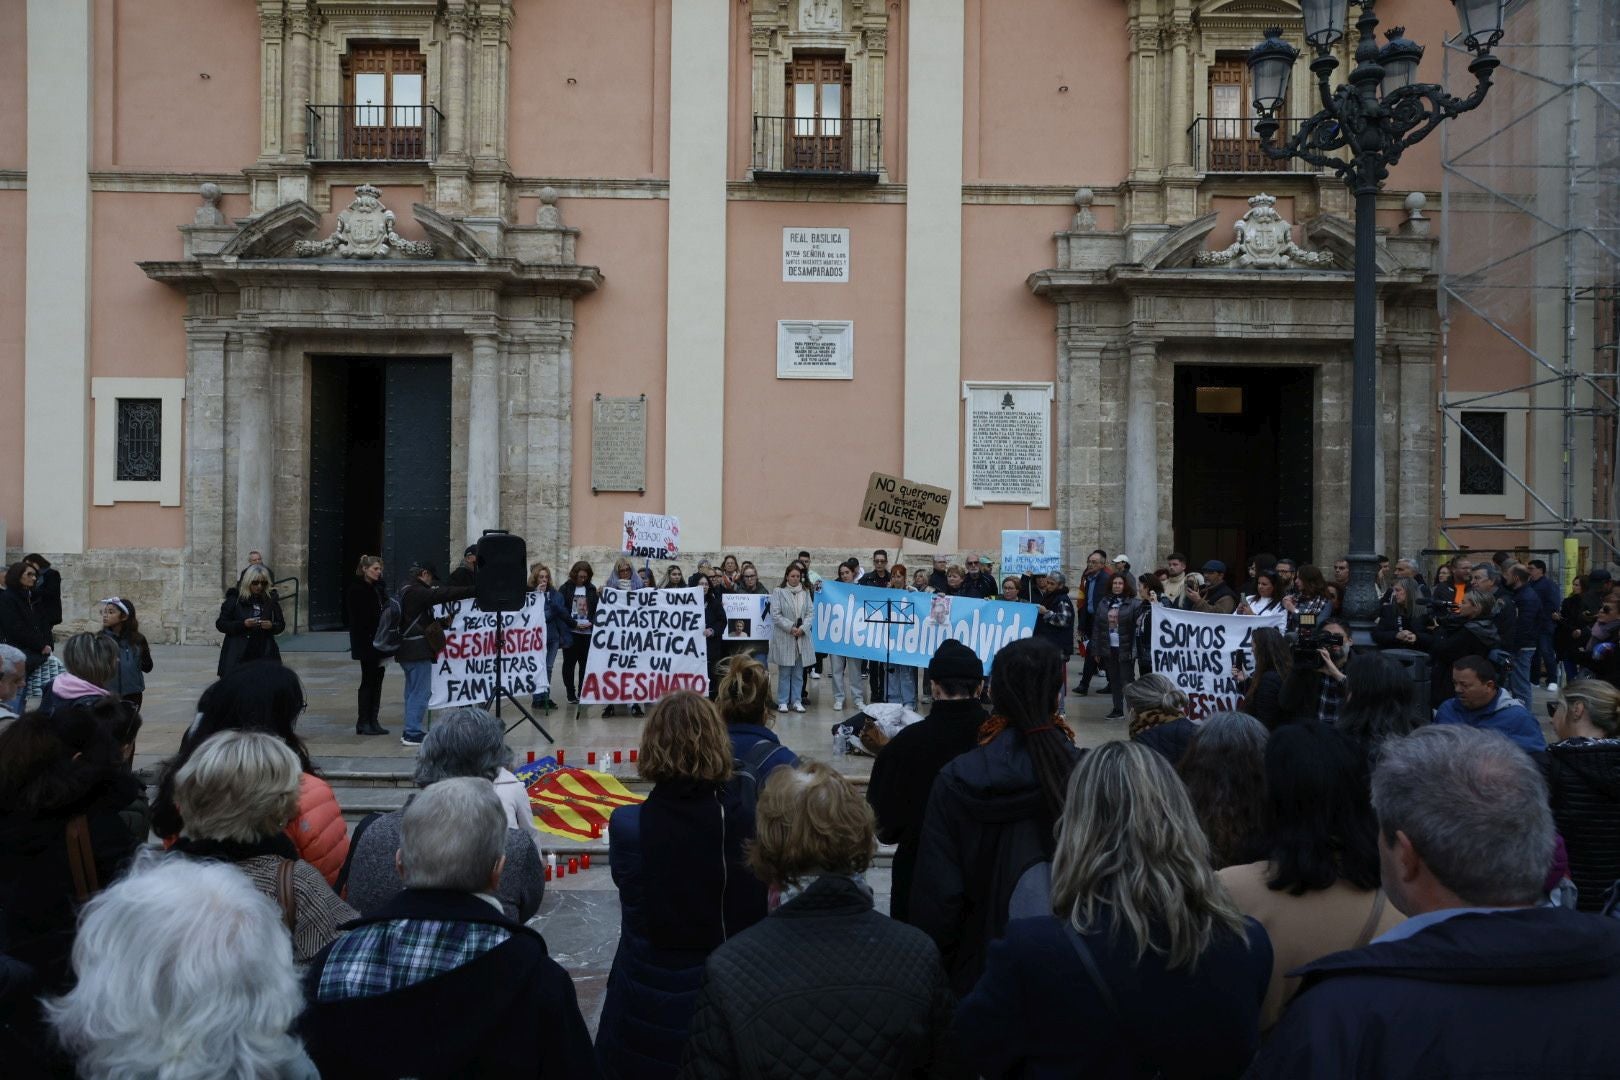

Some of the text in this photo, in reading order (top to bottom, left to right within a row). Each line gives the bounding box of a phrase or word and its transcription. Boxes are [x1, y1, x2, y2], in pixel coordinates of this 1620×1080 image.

[790, 232, 841, 243] REAL BASILICA
[803, 249, 825, 258] SEÑORA
[788, 266, 843, 276] DESAMPARADOS
[876, 477, 948, 504] NO queremos
[631, 546, 668, 559] MORIR
[600, 588, 617, 604] NO
[666, 592, 697, 605] UNA
[521, 613, 530, 627] Y
[595, 606, 702, 631] CATÁSTROFE
[1160, 619, 1226, 649] SOMOS
[439, 656, 538, 675] A NUESTRAS
[650, 656, 672, 672] UN
[1177, 673, 1204, 692] QUE
